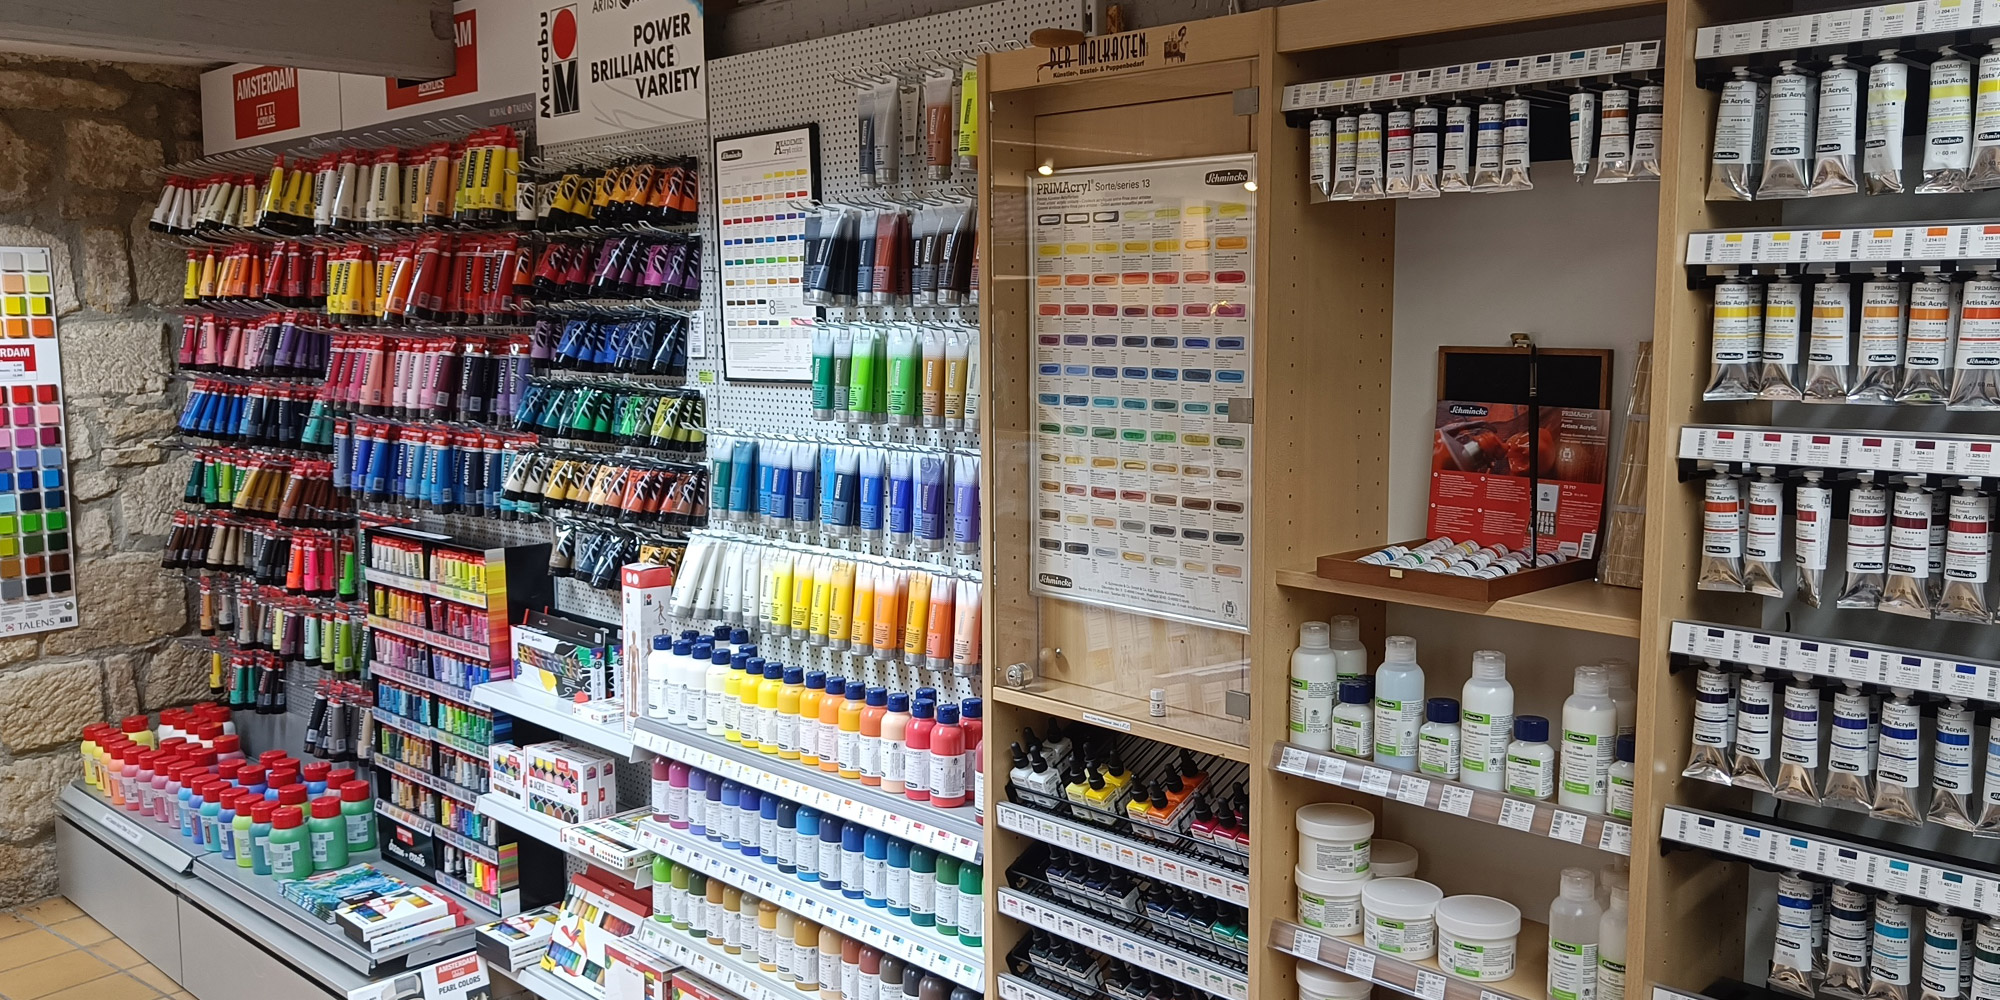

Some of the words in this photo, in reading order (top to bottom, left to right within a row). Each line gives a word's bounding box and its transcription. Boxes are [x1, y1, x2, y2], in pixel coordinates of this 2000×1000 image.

[634, 12, 691, 47] POWER
[1050, 46, 1071, 69] DER
[1078, 32, 1146, 66] MALKASTEN
[537, 11, 551, 119] Marabu
[591, 44, 674, 83] BRILLIANCE
[1106, 60, 1145, 72] Puppenbedarf
[237, 67, 295, 100] AMSTERDAM
[636, 66, 700, 99] VARIETY
[1876, 80, 1895, 90] Acrylic
[1828, 86, 1850, 94] Acrylic
[1206, 171, 1248, 184] Schmincke
[1095, 180, 1140, 191] Sorte/series
[1142, 179, 1150, 188] 13
[1450, 405, 1488, 416] Schmincke
[1039, 573, 1072, 588] Schmincke
[18, 618, 54, 630] TALENS
[1894, 720, 1915, 728] Acrylic
[1945, 726, 1968, 734] Acrylic
[1788, 890, 1810, 898] Acrylic
[1885, 918, 1906, 927] Acrylic
[1932, 929, 1954, 938] Acrylic
[438, 956, 476, 974] AMSTERDAM
[438, 984, 456, 994] PEARL
[458, 975, 480, 990] COLORS
